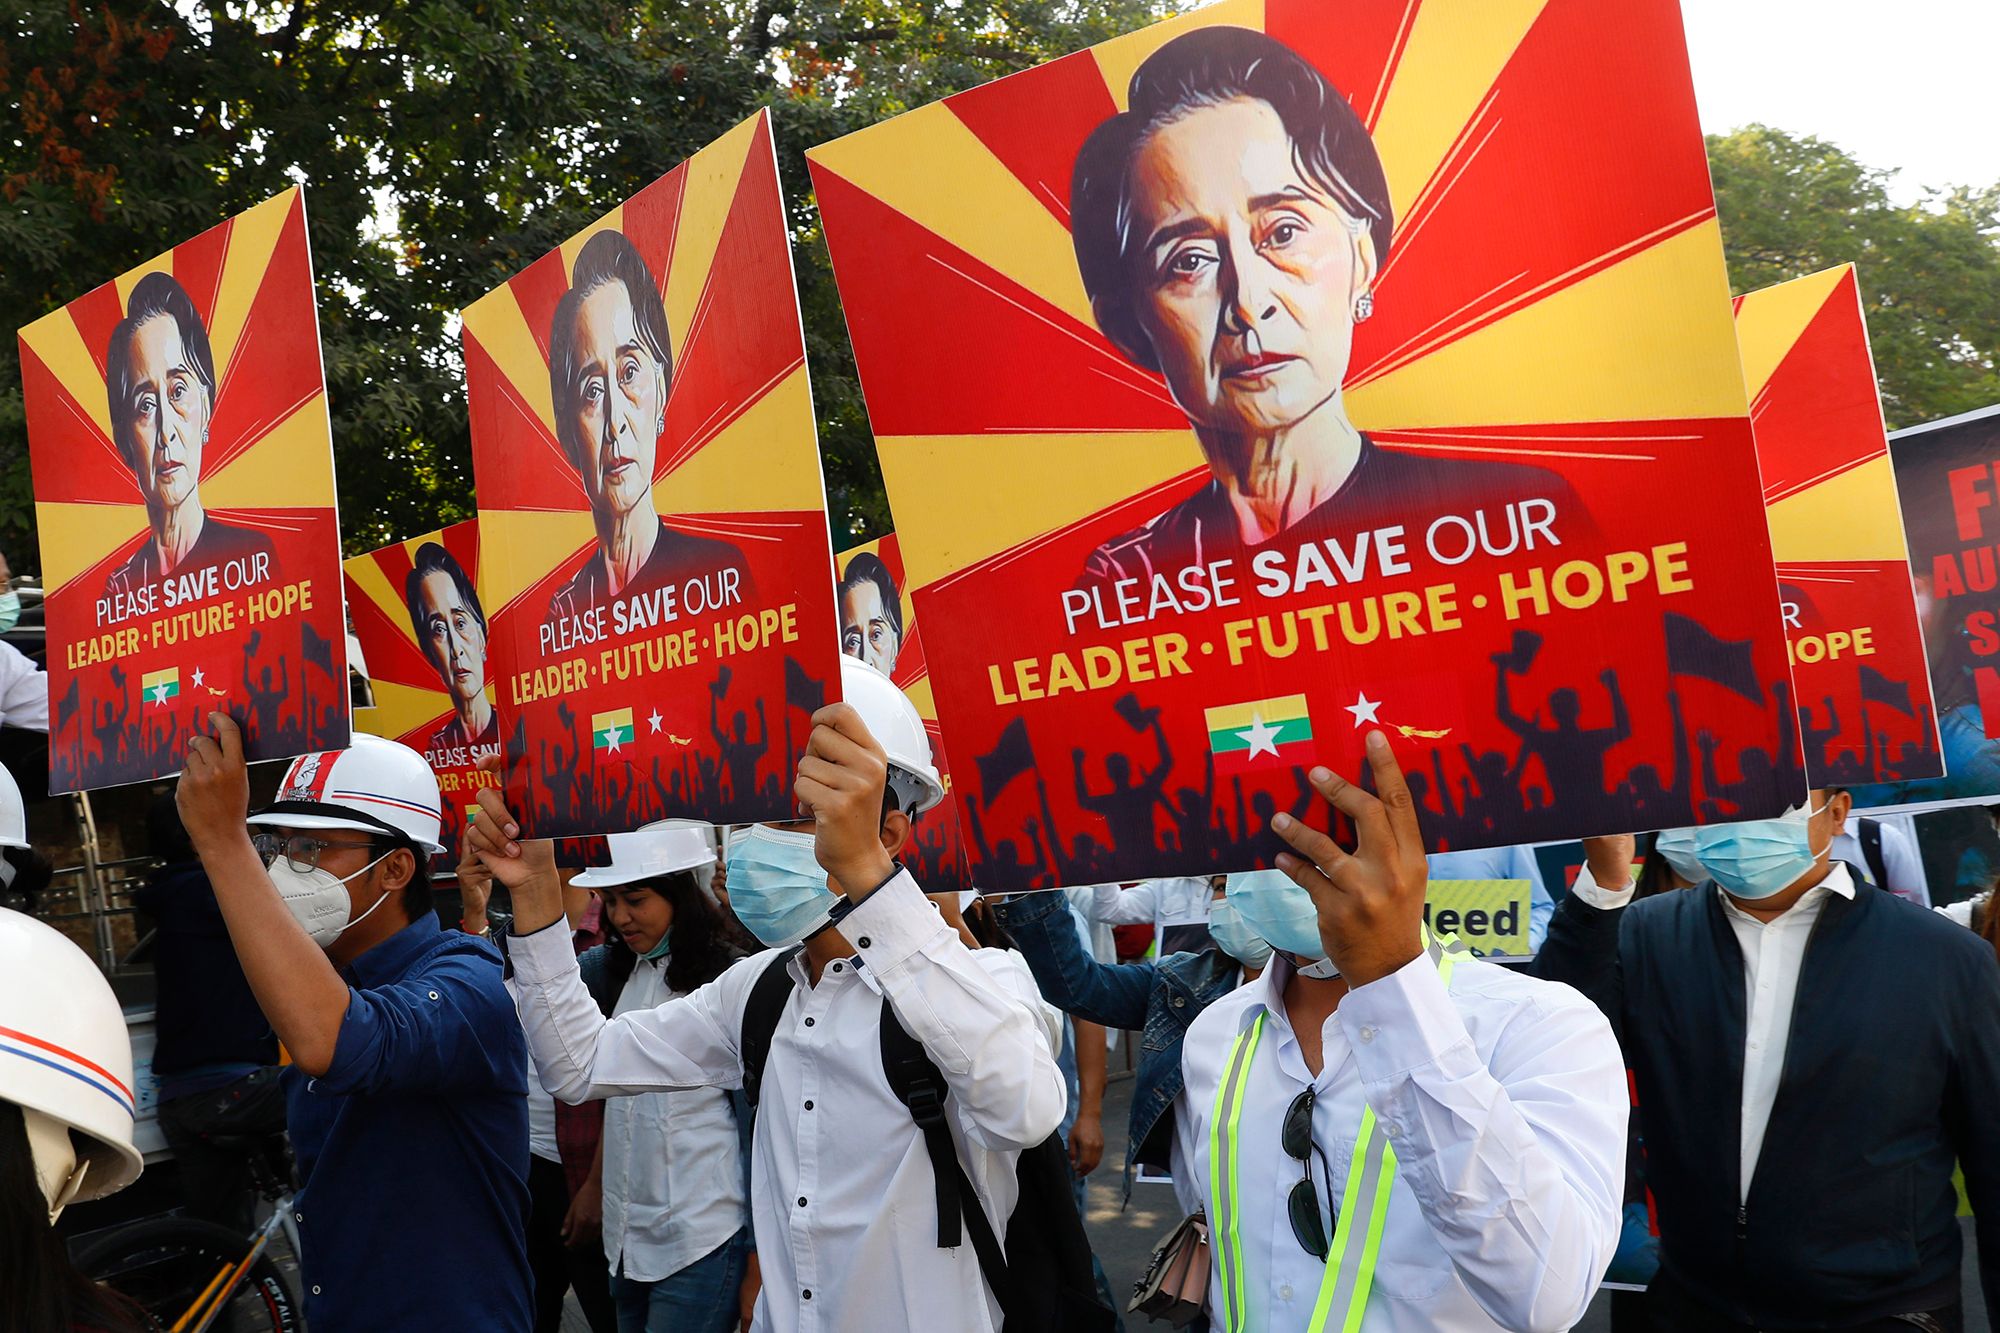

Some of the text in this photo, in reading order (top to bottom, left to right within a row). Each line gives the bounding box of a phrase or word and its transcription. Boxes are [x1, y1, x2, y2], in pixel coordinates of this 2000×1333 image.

[97, 552, 269, 626] PLEASE SAVE OUR
[1062, 498, 1561, 634] PLEASE SAVE OUR
[68, 581, 312, 669] LEADER FUTURE HOPE
[512, 604, 798, 705] LEADER FUTURE HOPE
[540, 568, 740, 656] PLEASE SAVE OUR
[989, 543, 1692, 704] LEADER FUTURE HOPE
[424, 747, 470, 769] PLEASE
